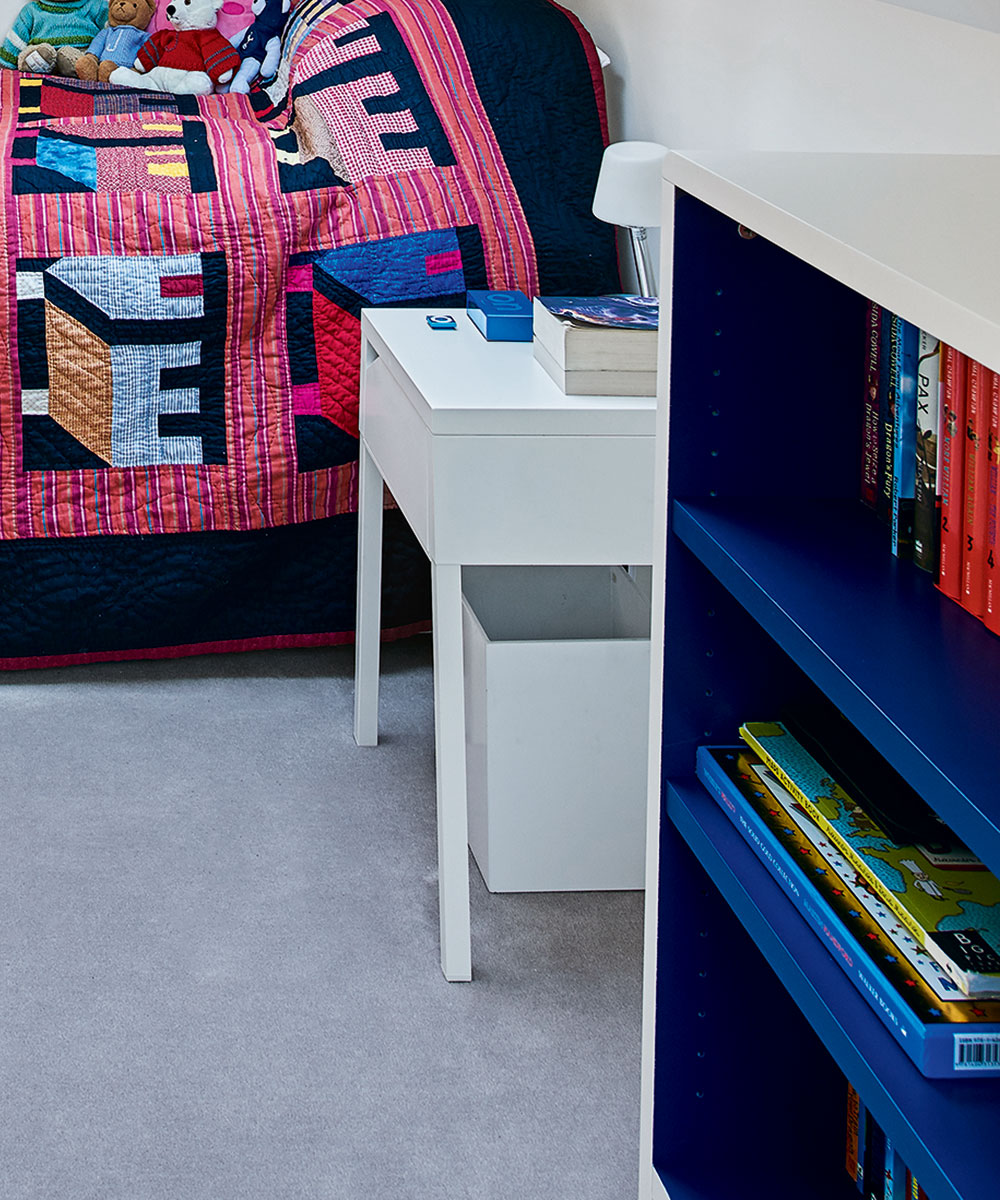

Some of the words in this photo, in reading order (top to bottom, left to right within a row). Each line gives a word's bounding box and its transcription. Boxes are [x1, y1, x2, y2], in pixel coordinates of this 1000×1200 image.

[107, 29, 124, 52] J
[870, 330, 879, 371] COWELL
[918, 374, 930, 414] PAX
[883, 471, 893, 499] Fury
[942, 516, 950, 533] 2
[967, 534, 974, 551] 3
[987, 549, 995, 568] 4
